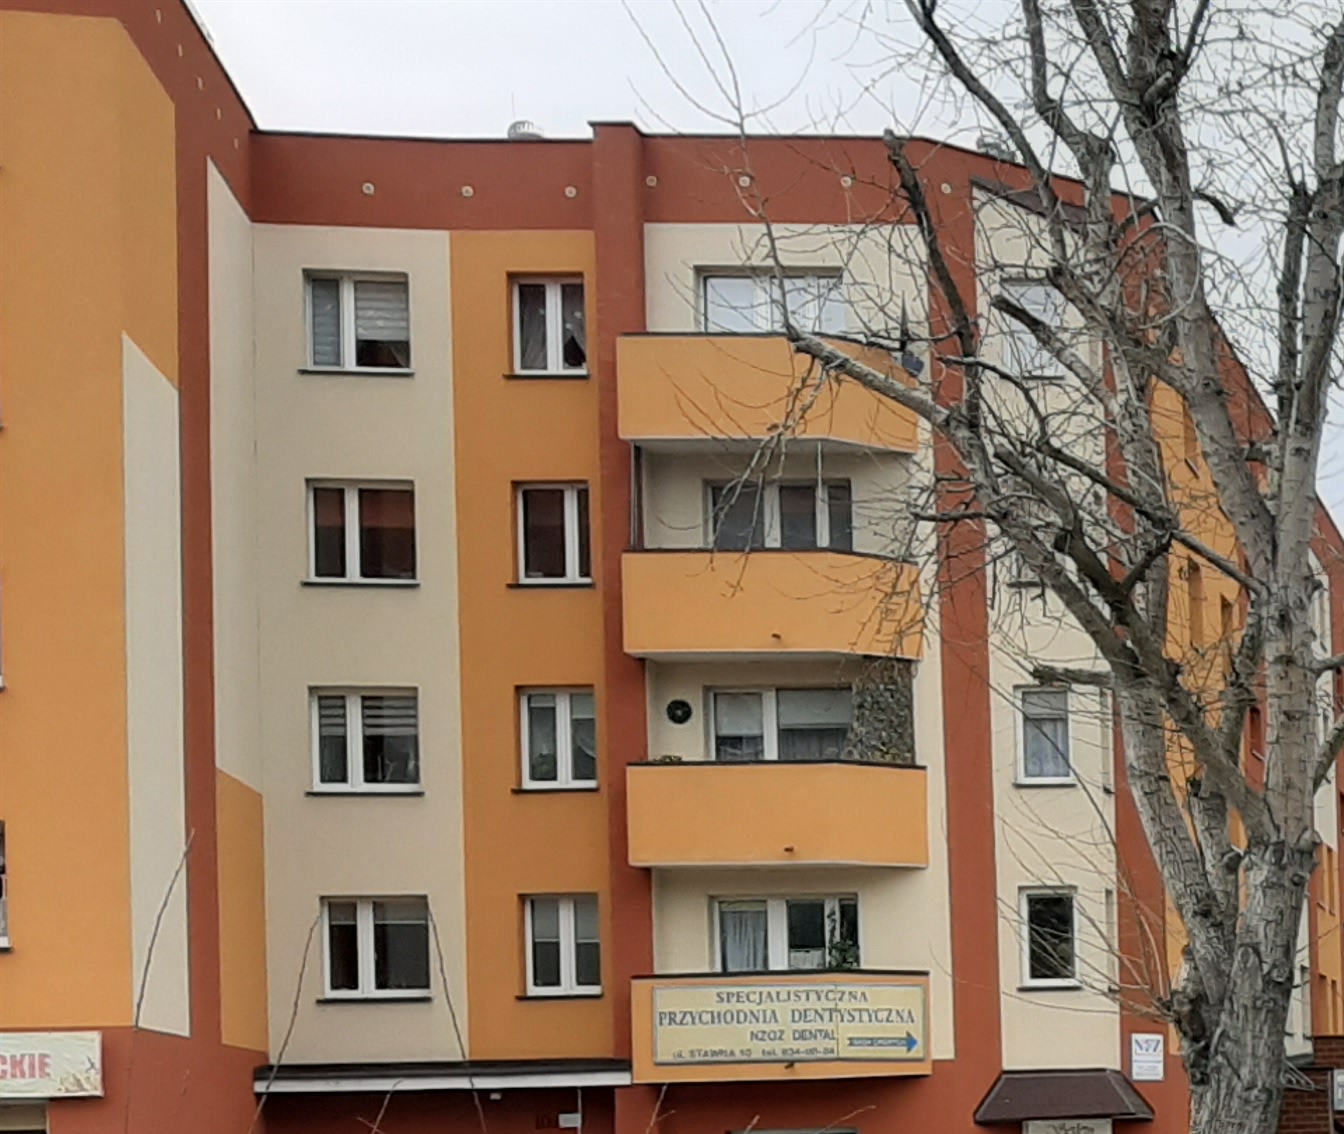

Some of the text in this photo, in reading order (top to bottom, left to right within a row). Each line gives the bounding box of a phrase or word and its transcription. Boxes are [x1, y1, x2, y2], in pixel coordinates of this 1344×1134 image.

[716, 989, 869, 1005] SPECJALISTYCZNA
[658, 1007, 916, 1026] PRZYCHODNIA DENTYSTYCZNA
[792, 1029, 837, 1041] DENTAL
